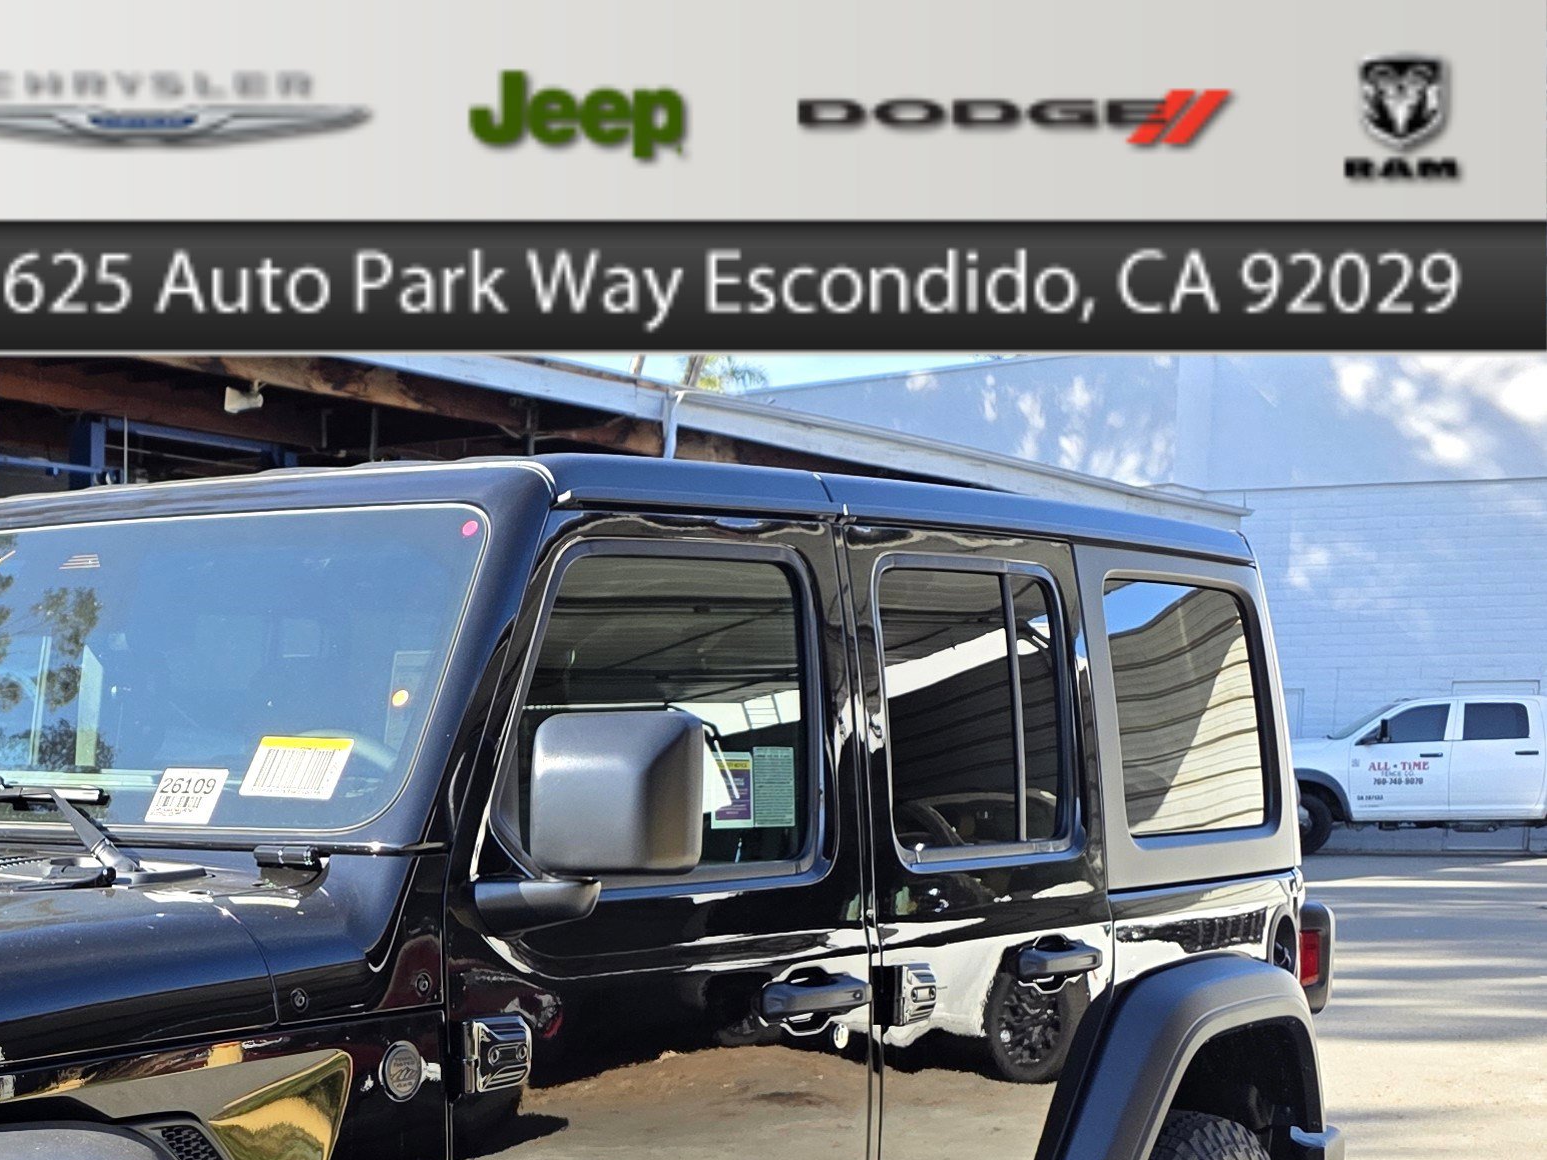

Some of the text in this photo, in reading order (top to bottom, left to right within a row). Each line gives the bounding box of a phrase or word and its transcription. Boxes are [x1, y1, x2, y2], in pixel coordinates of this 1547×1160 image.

[1368, 761, 1391, 771] ALL
[1400, 761, 1430, 771] TIME
[159, 777, 217, 795] 26109
